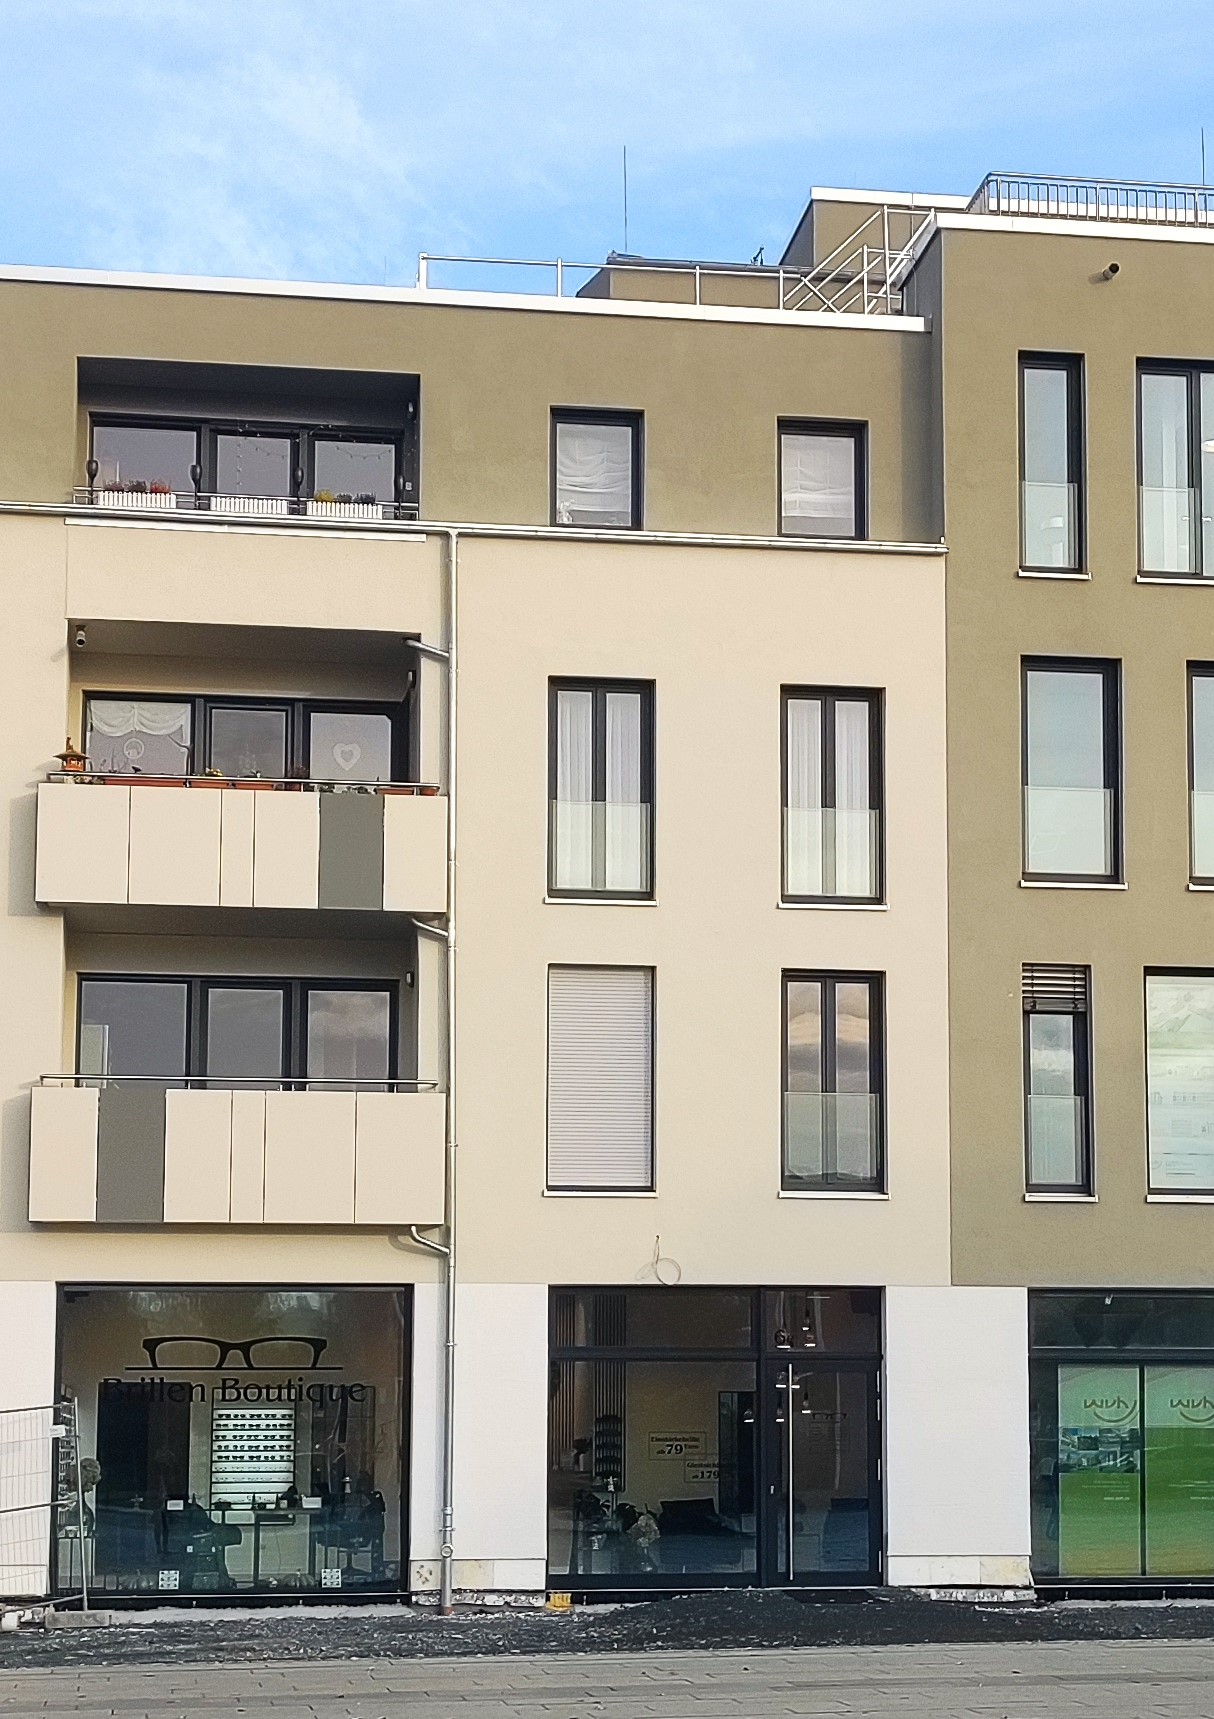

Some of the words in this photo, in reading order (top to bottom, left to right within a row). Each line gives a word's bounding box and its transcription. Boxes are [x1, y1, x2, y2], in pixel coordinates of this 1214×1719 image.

[103, 1376, 207, 1403] Brillen
[219, 1376, 367, 1409] Boutique
[1083, 1395, 1129, 1409] wvh
[665, 1443, 684, 1455] 79
